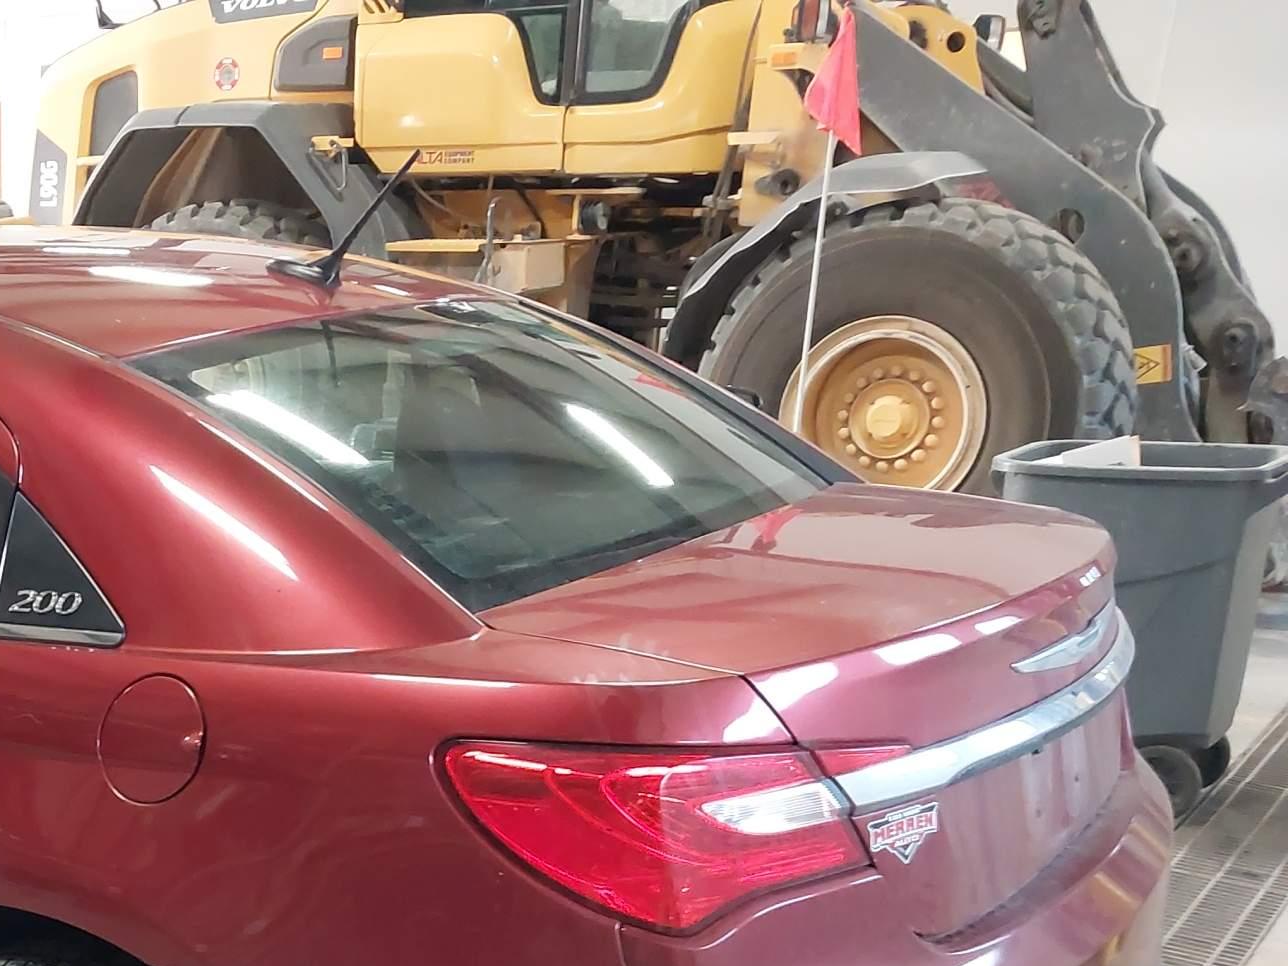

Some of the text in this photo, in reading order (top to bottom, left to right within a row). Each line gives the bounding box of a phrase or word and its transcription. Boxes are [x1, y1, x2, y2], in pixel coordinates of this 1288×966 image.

[221, 0, 305, 14] VOL
[39, 160, 58, 207] L90G
[8, 589, 83, 615] 200
